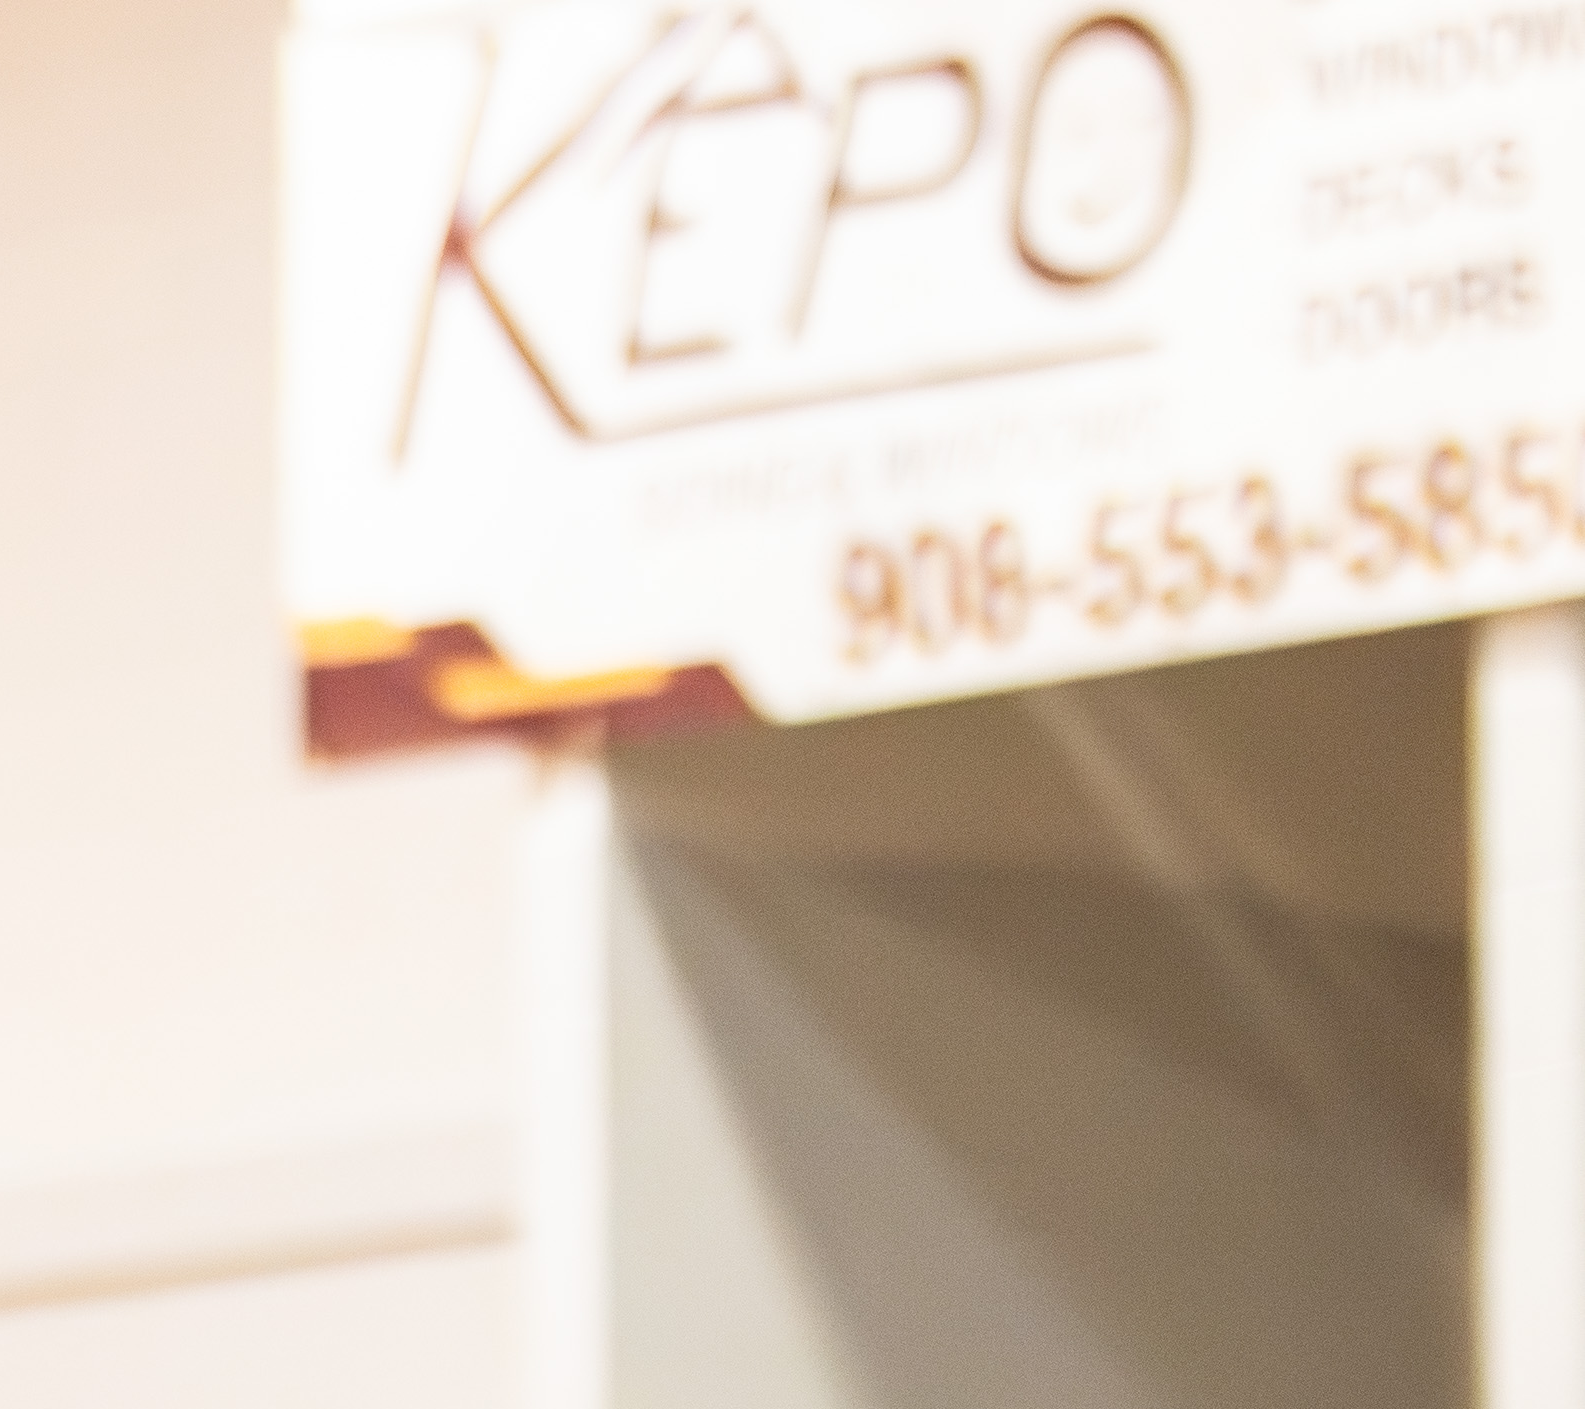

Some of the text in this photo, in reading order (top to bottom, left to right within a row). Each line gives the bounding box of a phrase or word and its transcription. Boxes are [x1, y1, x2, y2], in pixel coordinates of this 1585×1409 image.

[1302, 136, 1536, 244] DECKS
[1297, 253, 1553, 367] DOORS
[836, 412, 1585, 667] 908-553-585
